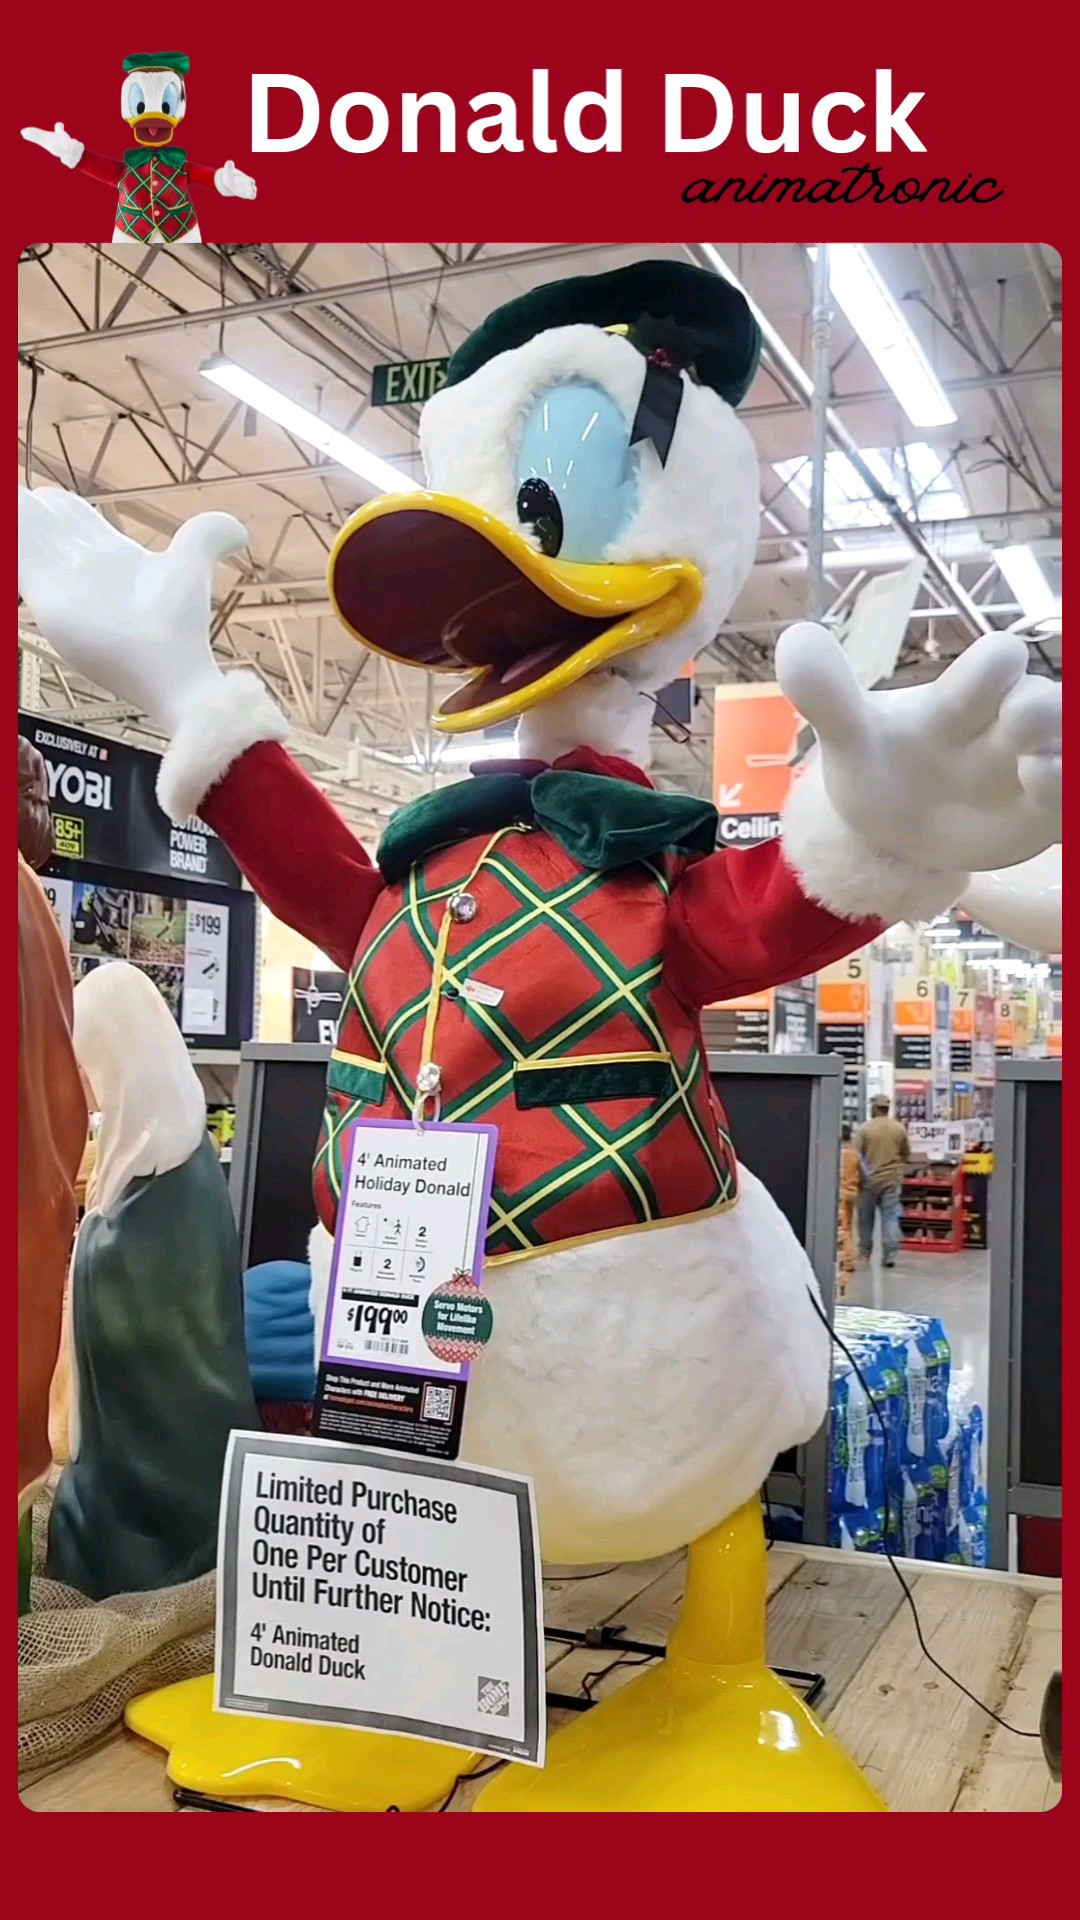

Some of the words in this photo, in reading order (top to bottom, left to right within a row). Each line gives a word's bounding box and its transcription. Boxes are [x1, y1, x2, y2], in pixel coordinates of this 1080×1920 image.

[386, 361, 441, 402] EXIT
[34, 729, 88, 757] EXCLUSIVELY
[87, 744, 99, 759] AT
[44, 759, 112, 811] YOBI
[55, 818, 82, 840] 85+
[720, 817, 783, 840] Ceilin
[169, 829, 208, 855] POWER
[169, 849, 208, 874] BRAND
[195, 913, 221, 936] $199
[847, 958, 862, 979] 5
[916, 980, 929, 998] 6
[957, 991, 969, 1008] 7
[1000, 1003, 1011, 1018] 8
[356, 1152, 372, 1167] 4'
[373, 1153, 448, 1172] Animated
[354, 1174, 411, 1196] Holiday
[415, 1178, 471, 1197] Donald
[351, 1200, 381, 1209] Features
[418, 1226, 428, 1238] 2
[383, 1258, 393, 1271] 2
[434, 1300, 456, 1311] Servo
[456, 1302, 483, 1314] Motors
[437, 1311, 449, 1321] for
[450, 1312, 477, 1324] Lifelike
[436, 1321, 476, 1335] Movement
[255, 1471, 344, 1506] Limited
[351, 1480, 458, 1525] Purchase
[254, 1505, 355, 1547] Quantity
[361, 1518, 387, 1545] of
[252, 1538, 299, 1569] One
[306, 1544, 348, 1574] Per
[354, 1549, 469, 1593] Customer
[252, 1571, 306, 1603] Until
[313, 1578, 404, 1615] Further
[410, 1590, 492, 1633] Notice:
[250, 1622, 267, 1643] 4'
[271, 1624, 361, 1655] Animated
[250, 1645, 313, 1674] Donald
[318, 1654, 367, 1681] Duck
